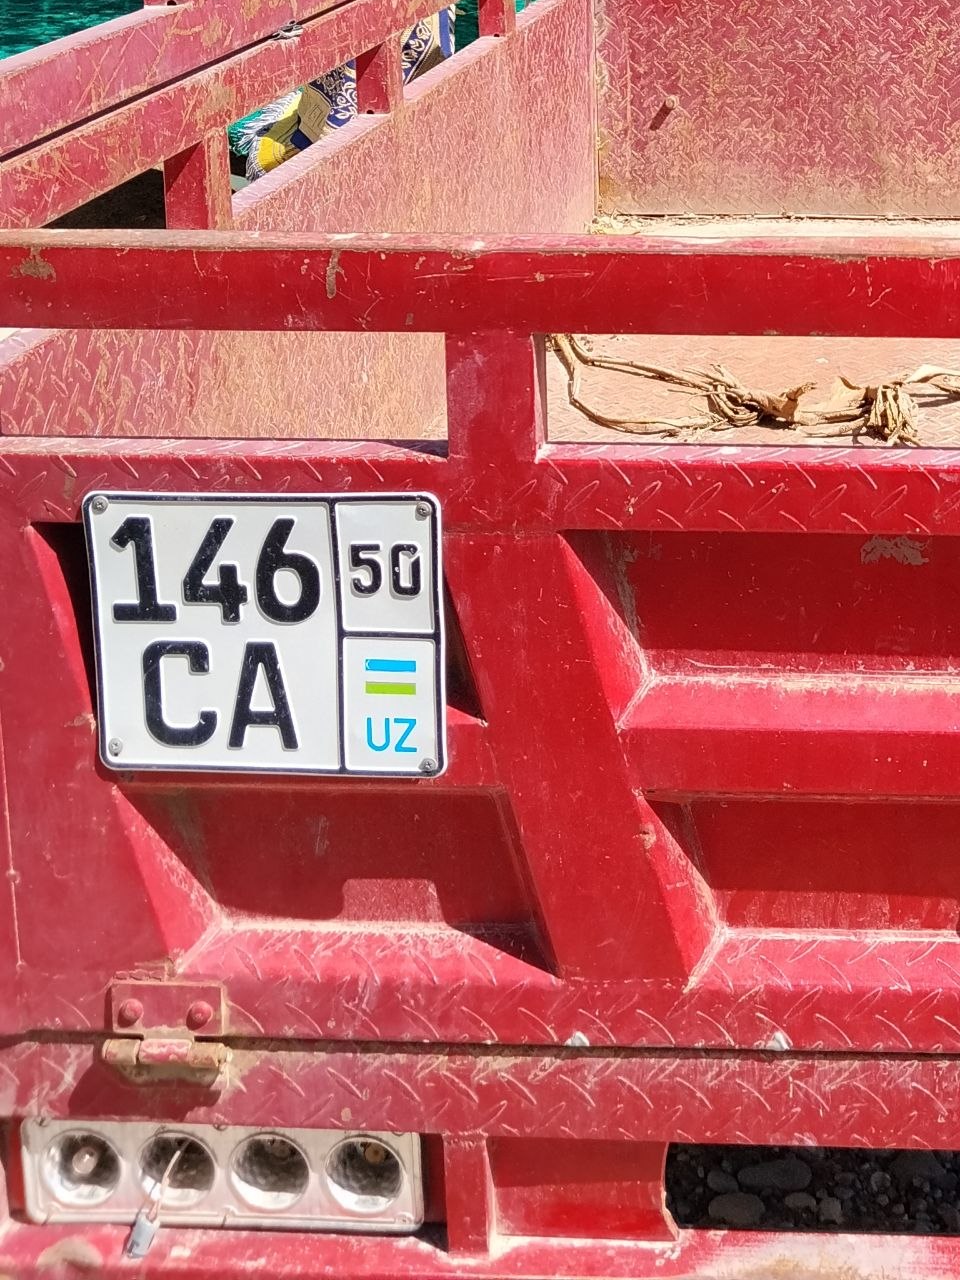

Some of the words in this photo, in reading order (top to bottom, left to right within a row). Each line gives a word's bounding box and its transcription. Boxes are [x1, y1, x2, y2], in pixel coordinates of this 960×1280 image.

[110, 517, 321, 623] 146
[348, 544, 422, 596] 50
[142, 640, 299, 751] CA
[365, 718, 418, 753] UZ
